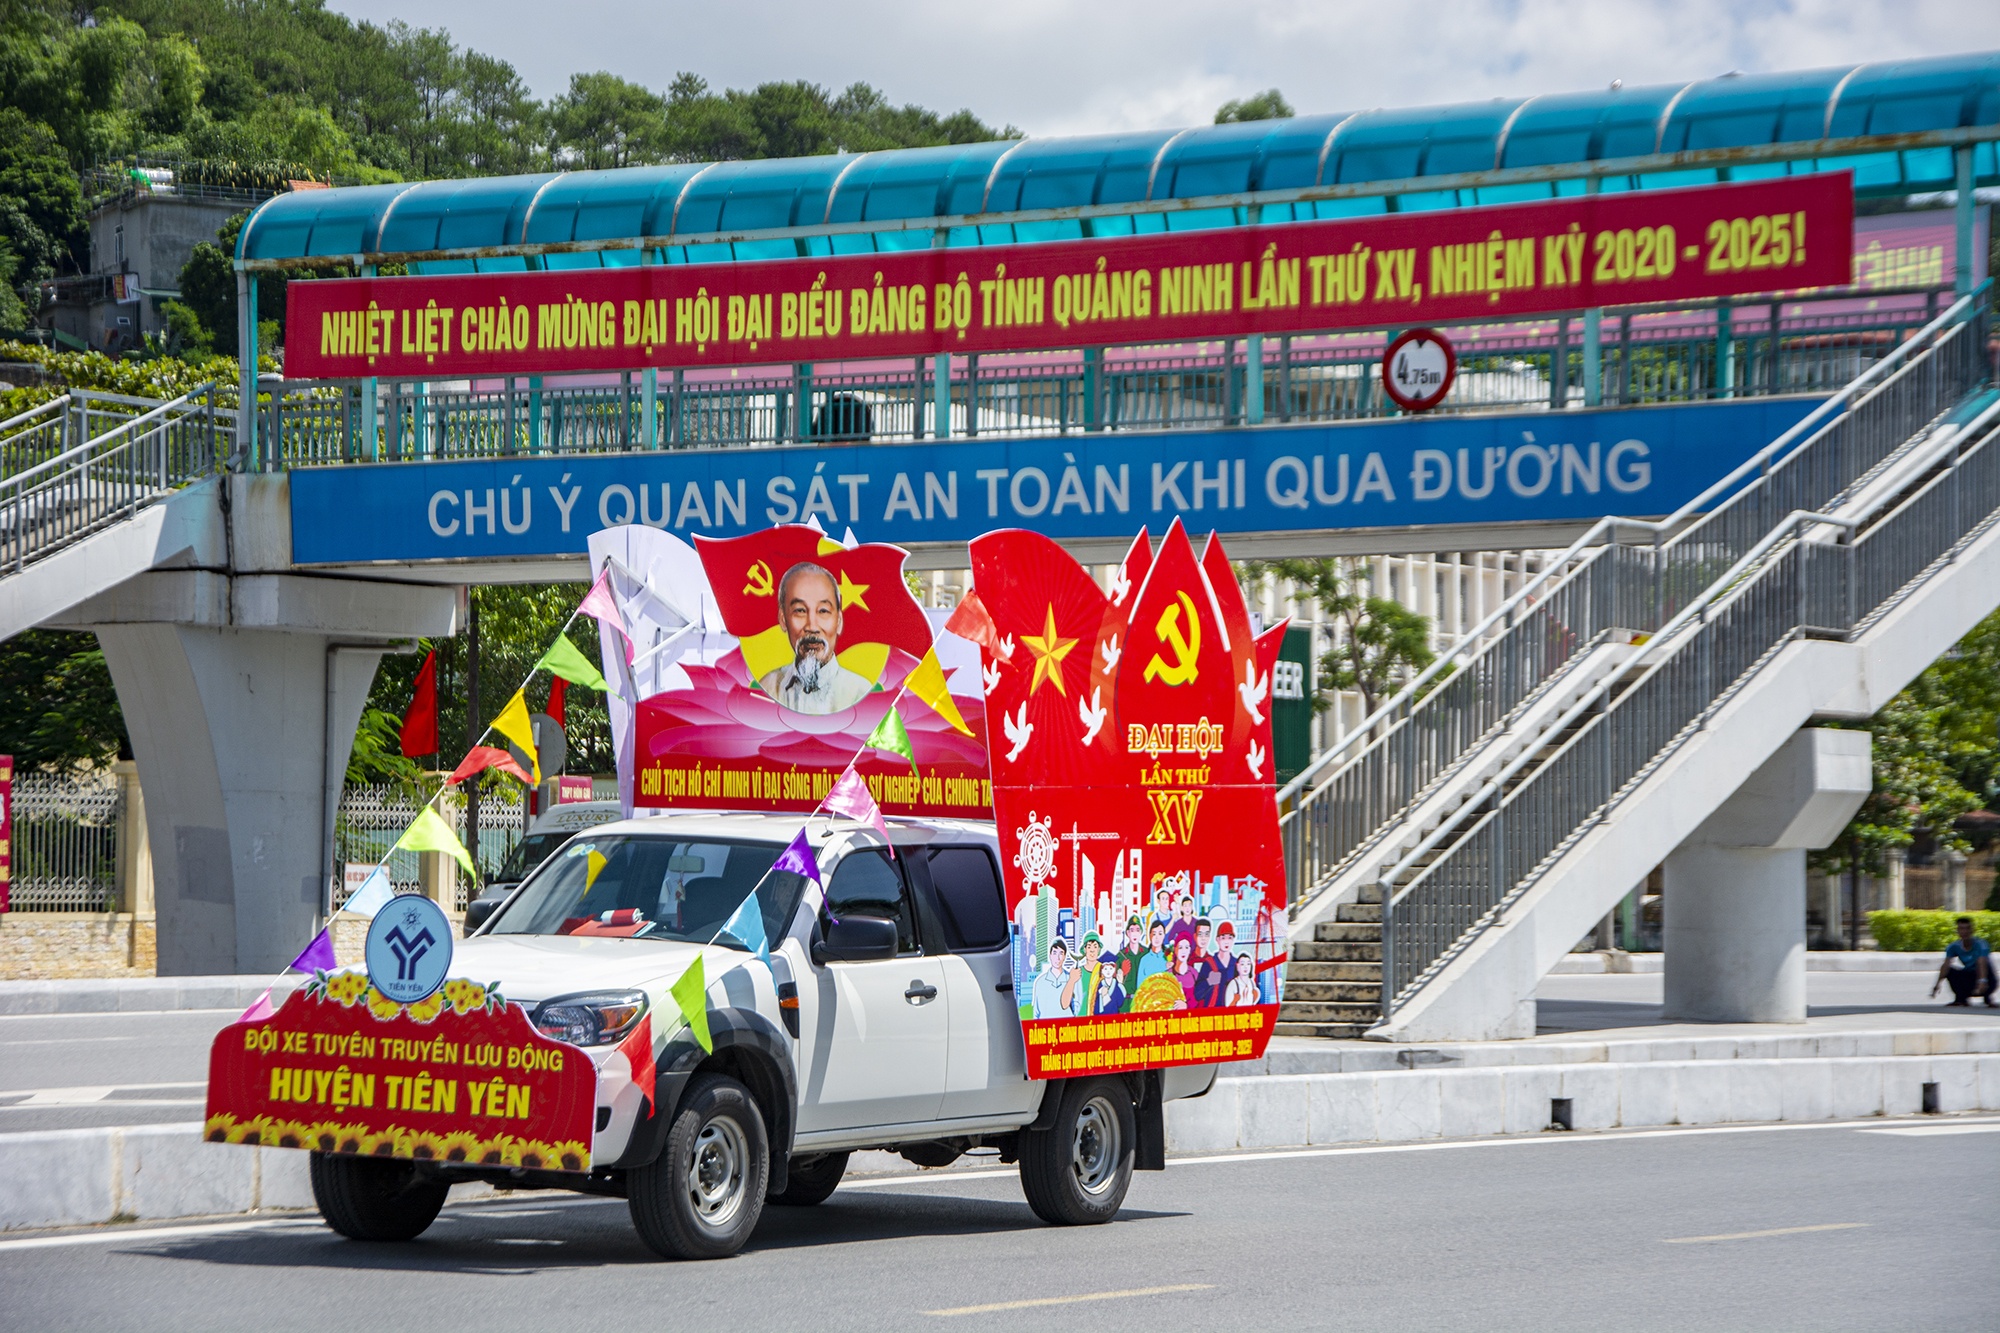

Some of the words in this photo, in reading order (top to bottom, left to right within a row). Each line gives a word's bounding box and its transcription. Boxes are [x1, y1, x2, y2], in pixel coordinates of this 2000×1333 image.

[321, 300, 395, 364] NHIỆT
[402, 298, 454, 363] LIỆT
[461, 296, 529, 351] CHÀO
[538, 293, 615, 349] MỪNG
[624, 298, 667, 354] ĐẠI
[675, 287, 719, 353] HỘI
[727, 293, 772, 350] ĐẠI
[781, 271, 842, 338] BIỂU
[850, 271, 926, 334] ĐẢNG
[935, 271, 972, 339] BỘ
[979, 263, 1044, 327] TỈNH
[1053, 256, 1151, 328] QUẢNG
[1159, 262, 1233, 315] NINH
[1242, 242, 1300, 310] LẦN
[1308, 242, 1371, 304] THỨ
[1375, 248, 1422, 303] XV,
[1430, 229, 1536, 304] NHIỆM
[1544, 221, 1587, 287] KỲ
[1593, 224, 1676, 284] 2020
[1683, 245, 1700, 259] -
[1705, 210, 1807, 274] 2025!
[427, 473, 531, 537] CHÚ
[549, 472, 582, 533] Ý
[599, 478, 747, 528] QUAN
[765, 461, 870, 524] SÁT
[883, 471, 958, 521] AN
[976, 452, 1130, 518] TOÀN
[1152, 458, 1246, 512] KHI
[1264, 452, 1396, 509] QUA
[1410, 431, 1652, 500] ĐƯỜNG
[1128, 723, 1174, 760] ĐẠI
[1176, 716, 1224, 760] HỘI
[641, 760, 661, 796] CHỦ
[664, 769, 686, 802] TỊCH
[688, 761, 702, 797] HỒ
[704, 765, 721, 798] CHÍ
[723, 771, 750, 798] MINH
[752, 766, 762, 798] VĨ
[764, 772, 781, 805] ĐẠI
[783, 763, 810, 800] SỐNG
[813, 768, 832, 800] MÃI
[869, 773, 882, 809] SỰ
[885, 771, 920, 810] NGHIỆP
[923, 768, 943, 805] CỦA
[945, 772, 979, 806] CHÚNG
[1140, 761, 1173, 785] LẦN
[1176, 764, 1211, 785] THỨ
[556, 813, 613, 823] LUXURY
[1146, 790, 1203, 845] XV
[388, 982, 406, 991] TIÊN
[408, 983, 424, 992] YÊN
[244, 1025, 278, 1056] ĐỘI
[282, 1032, 308, 1053] XE
[312, 1030, 376, 1058] TUYÊN
[380, 1033, 458, 1064] TRUYỀN
[463, 1044, 502, 1068] LƯU
[507, 1042, 564, 1075] ĐỘNG
[269, 1064, 376, 1114] HUYỆN
[384, 1070, 458, 1113] TIÊN
[467, 1076, 531, 1119] YÊN
